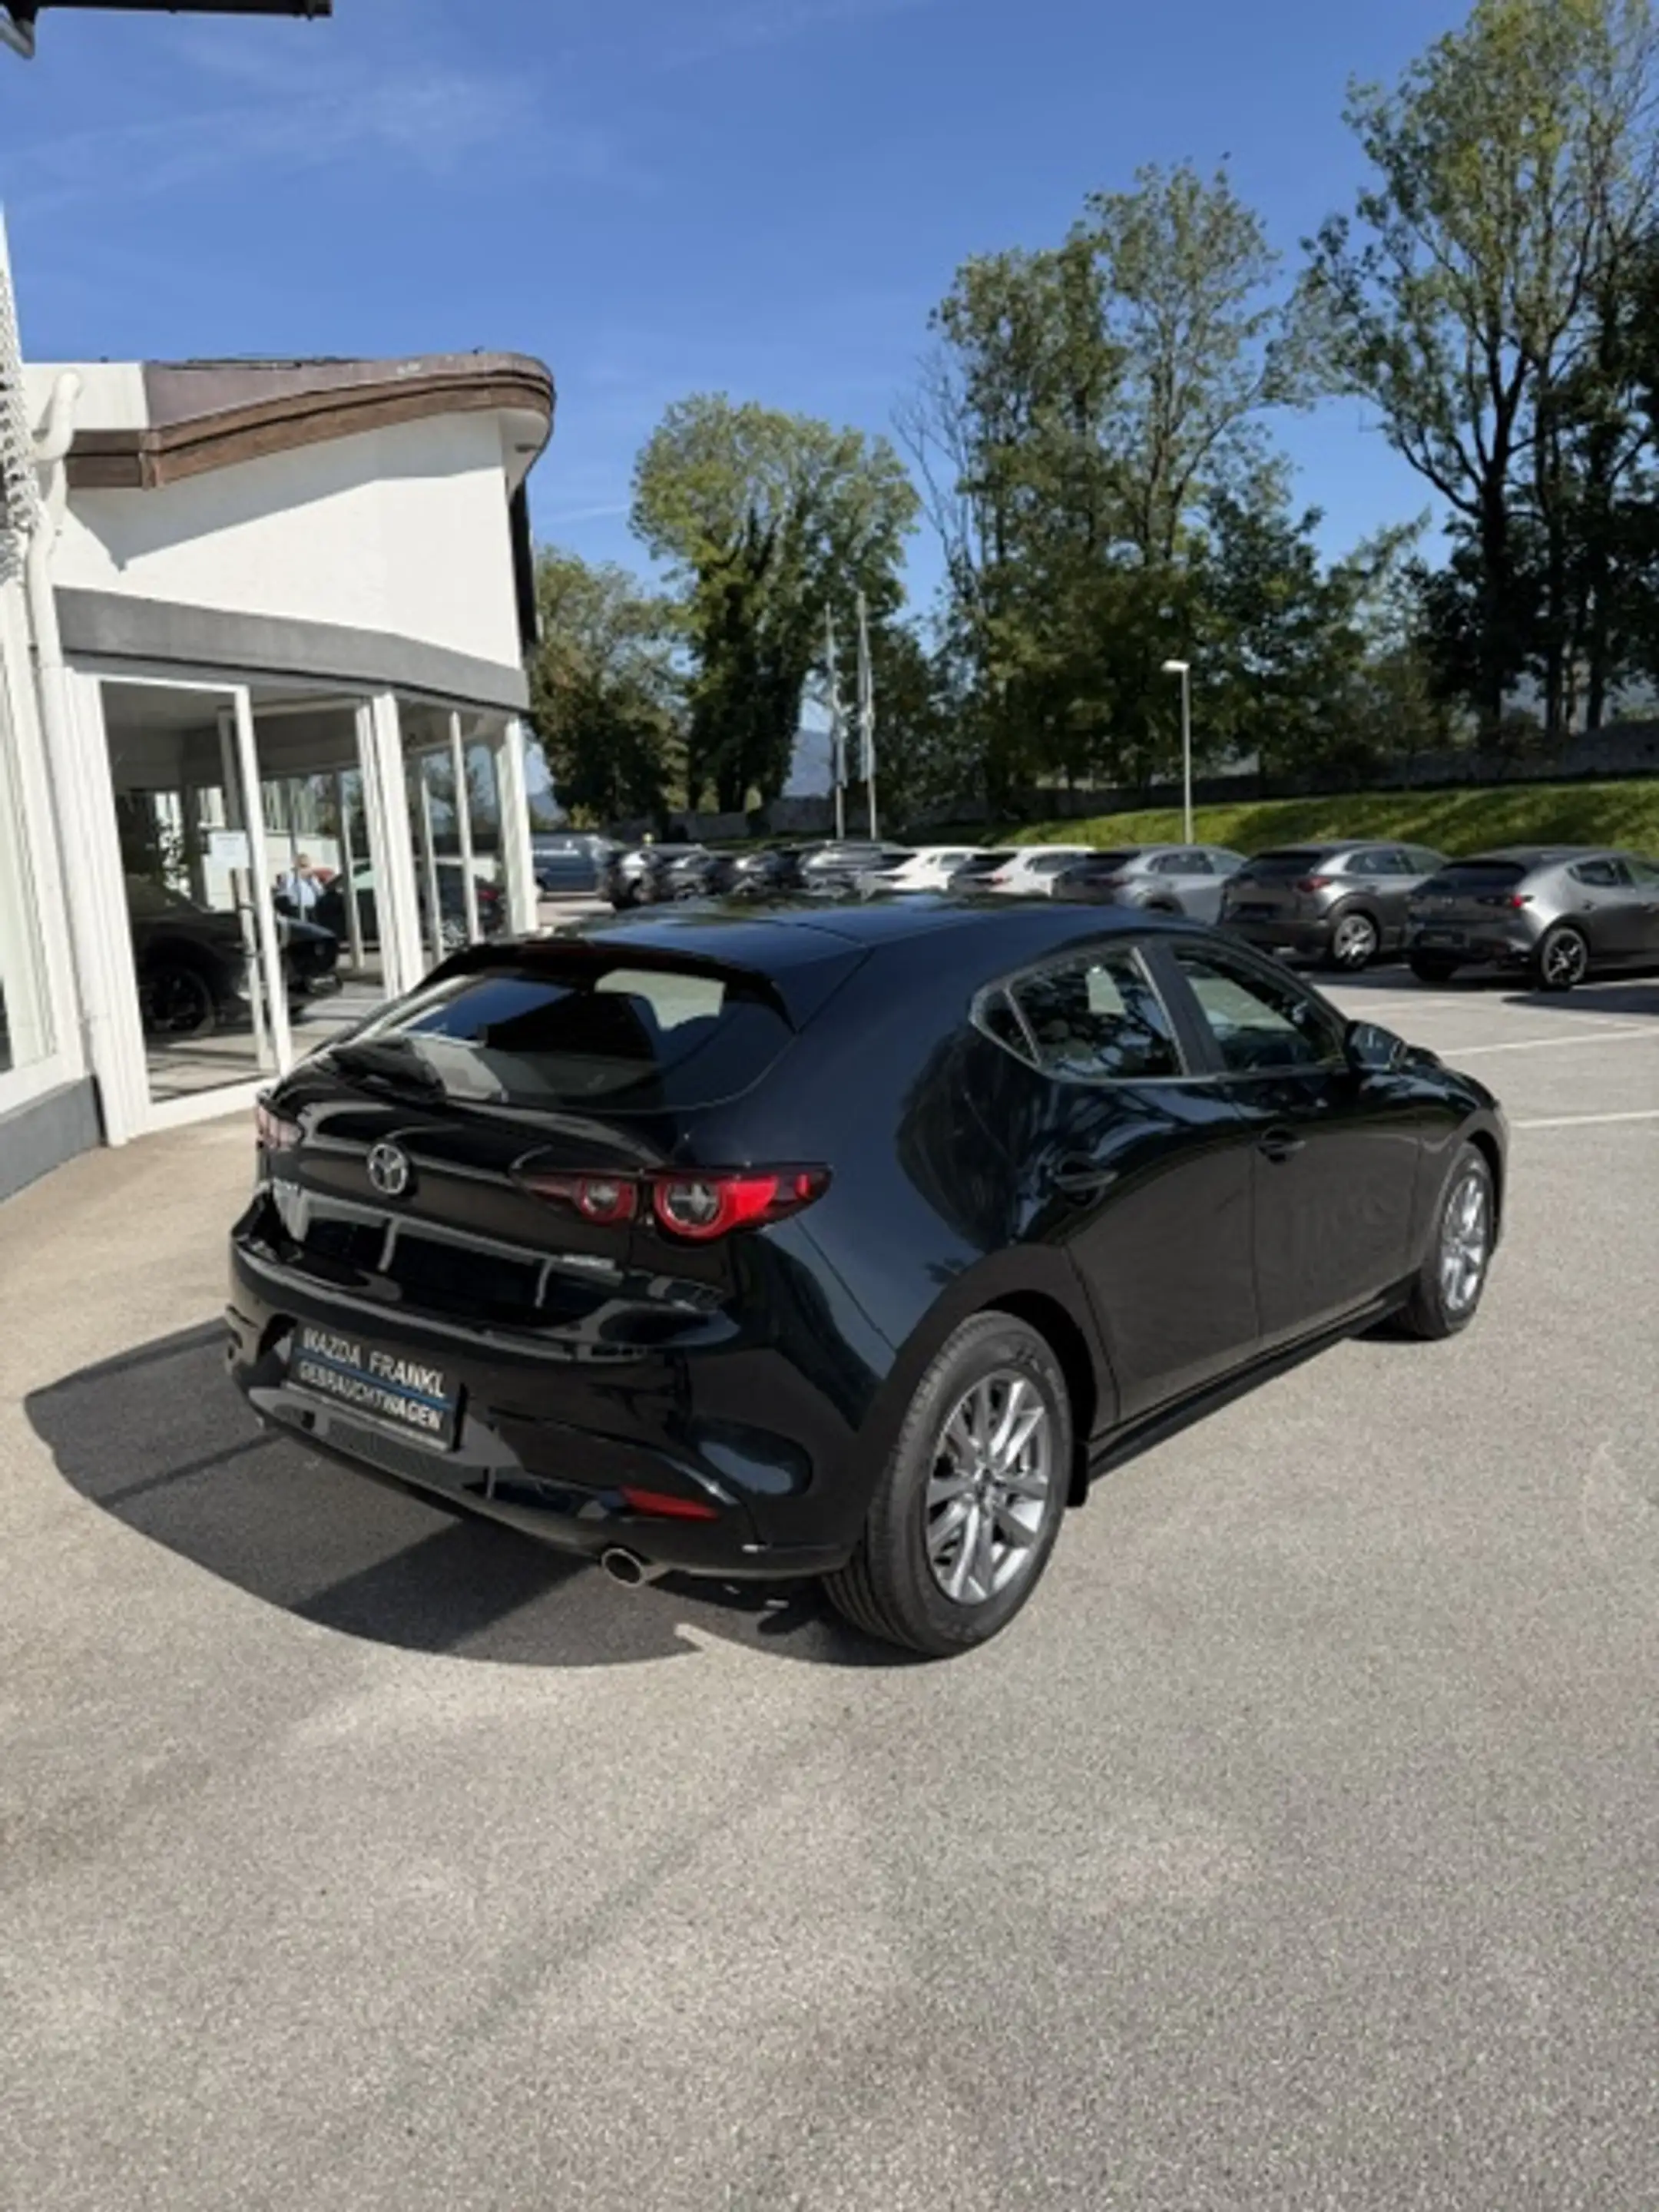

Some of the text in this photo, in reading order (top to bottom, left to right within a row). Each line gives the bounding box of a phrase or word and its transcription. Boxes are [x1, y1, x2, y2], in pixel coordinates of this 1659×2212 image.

[299, 1360, 443, 1432] GEBRAUCHTWAGEN
[303, 1327, 445, 1398] MAZDA FRANKL
